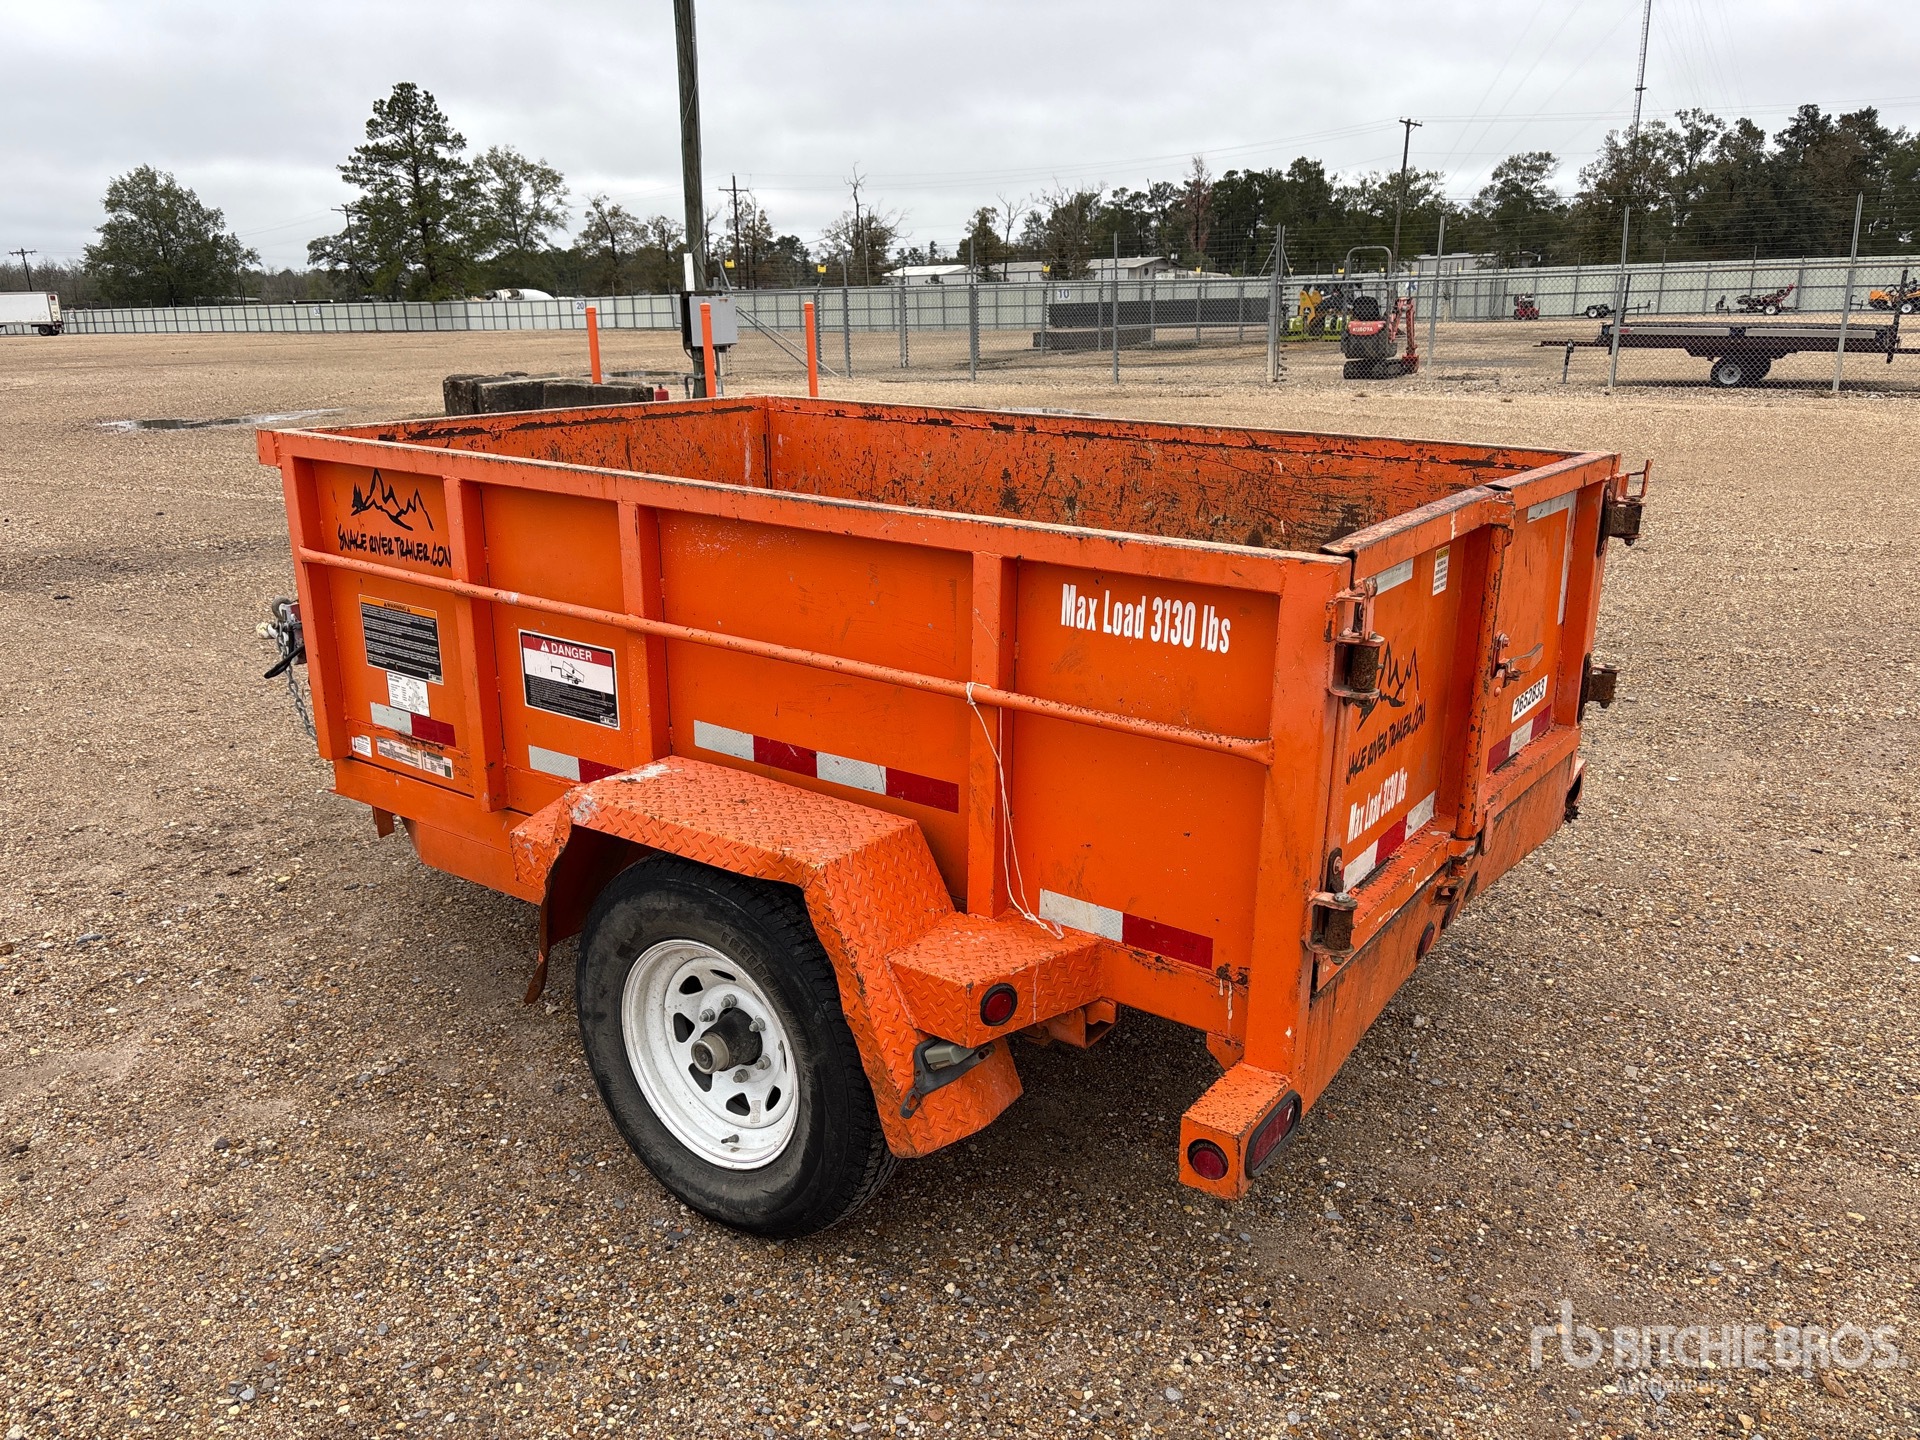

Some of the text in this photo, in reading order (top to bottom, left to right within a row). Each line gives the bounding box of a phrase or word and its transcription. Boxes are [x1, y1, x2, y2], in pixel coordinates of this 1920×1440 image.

[576, 301, 585, 310] 20
[337, 523, 367, 551] SNAKE
[369, 531, 394, 556] RIVER
[1061, 583, 1231, 654] Max Load 3130 lbs
[551, 643, 592, 661] DANGER
[1347, 766, 1408, 845] Max Load 3130 lbs
